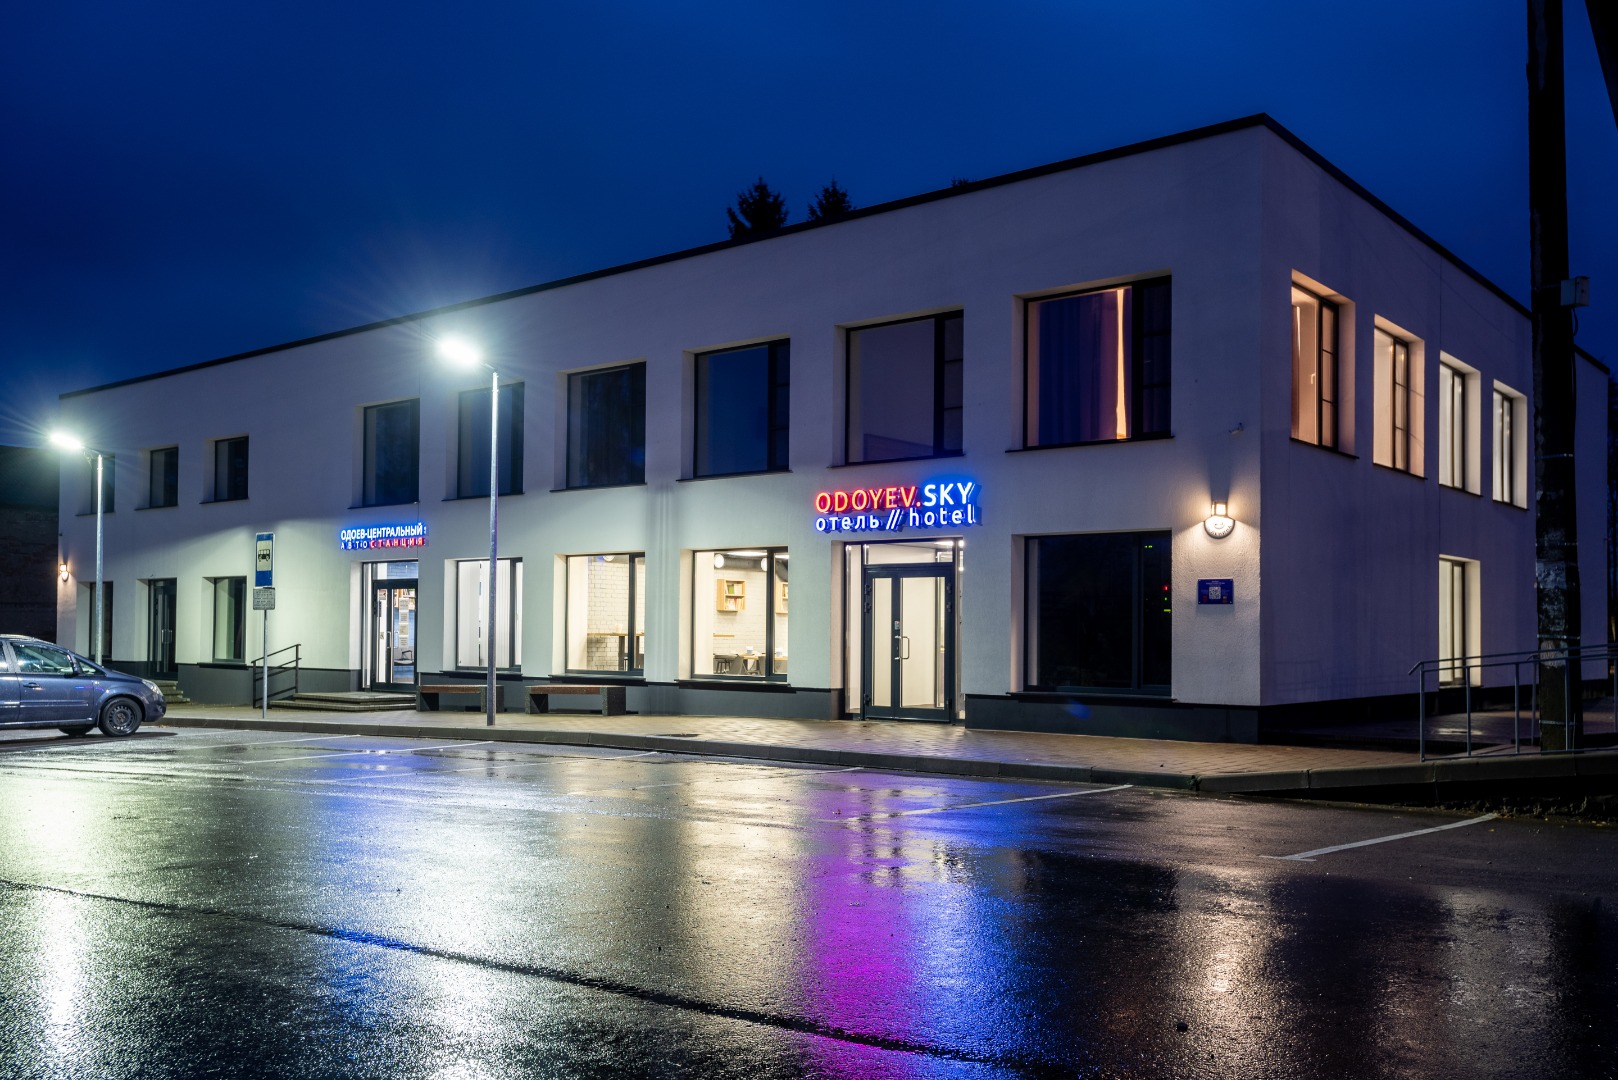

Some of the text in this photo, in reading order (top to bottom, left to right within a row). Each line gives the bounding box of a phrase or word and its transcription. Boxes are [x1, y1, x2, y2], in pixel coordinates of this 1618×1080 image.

[815, 482, 974, 513] ODOYEV.SKY
[815, 514, 880, 532] отель
[909, 503, 976, 526] hotel
[340, 523, 423, 541] ОДОЕВ-ЦЕНТРАЛЬНЫЙ
[340, 537, 424, 549] АВТОСТАНЦИЯ
